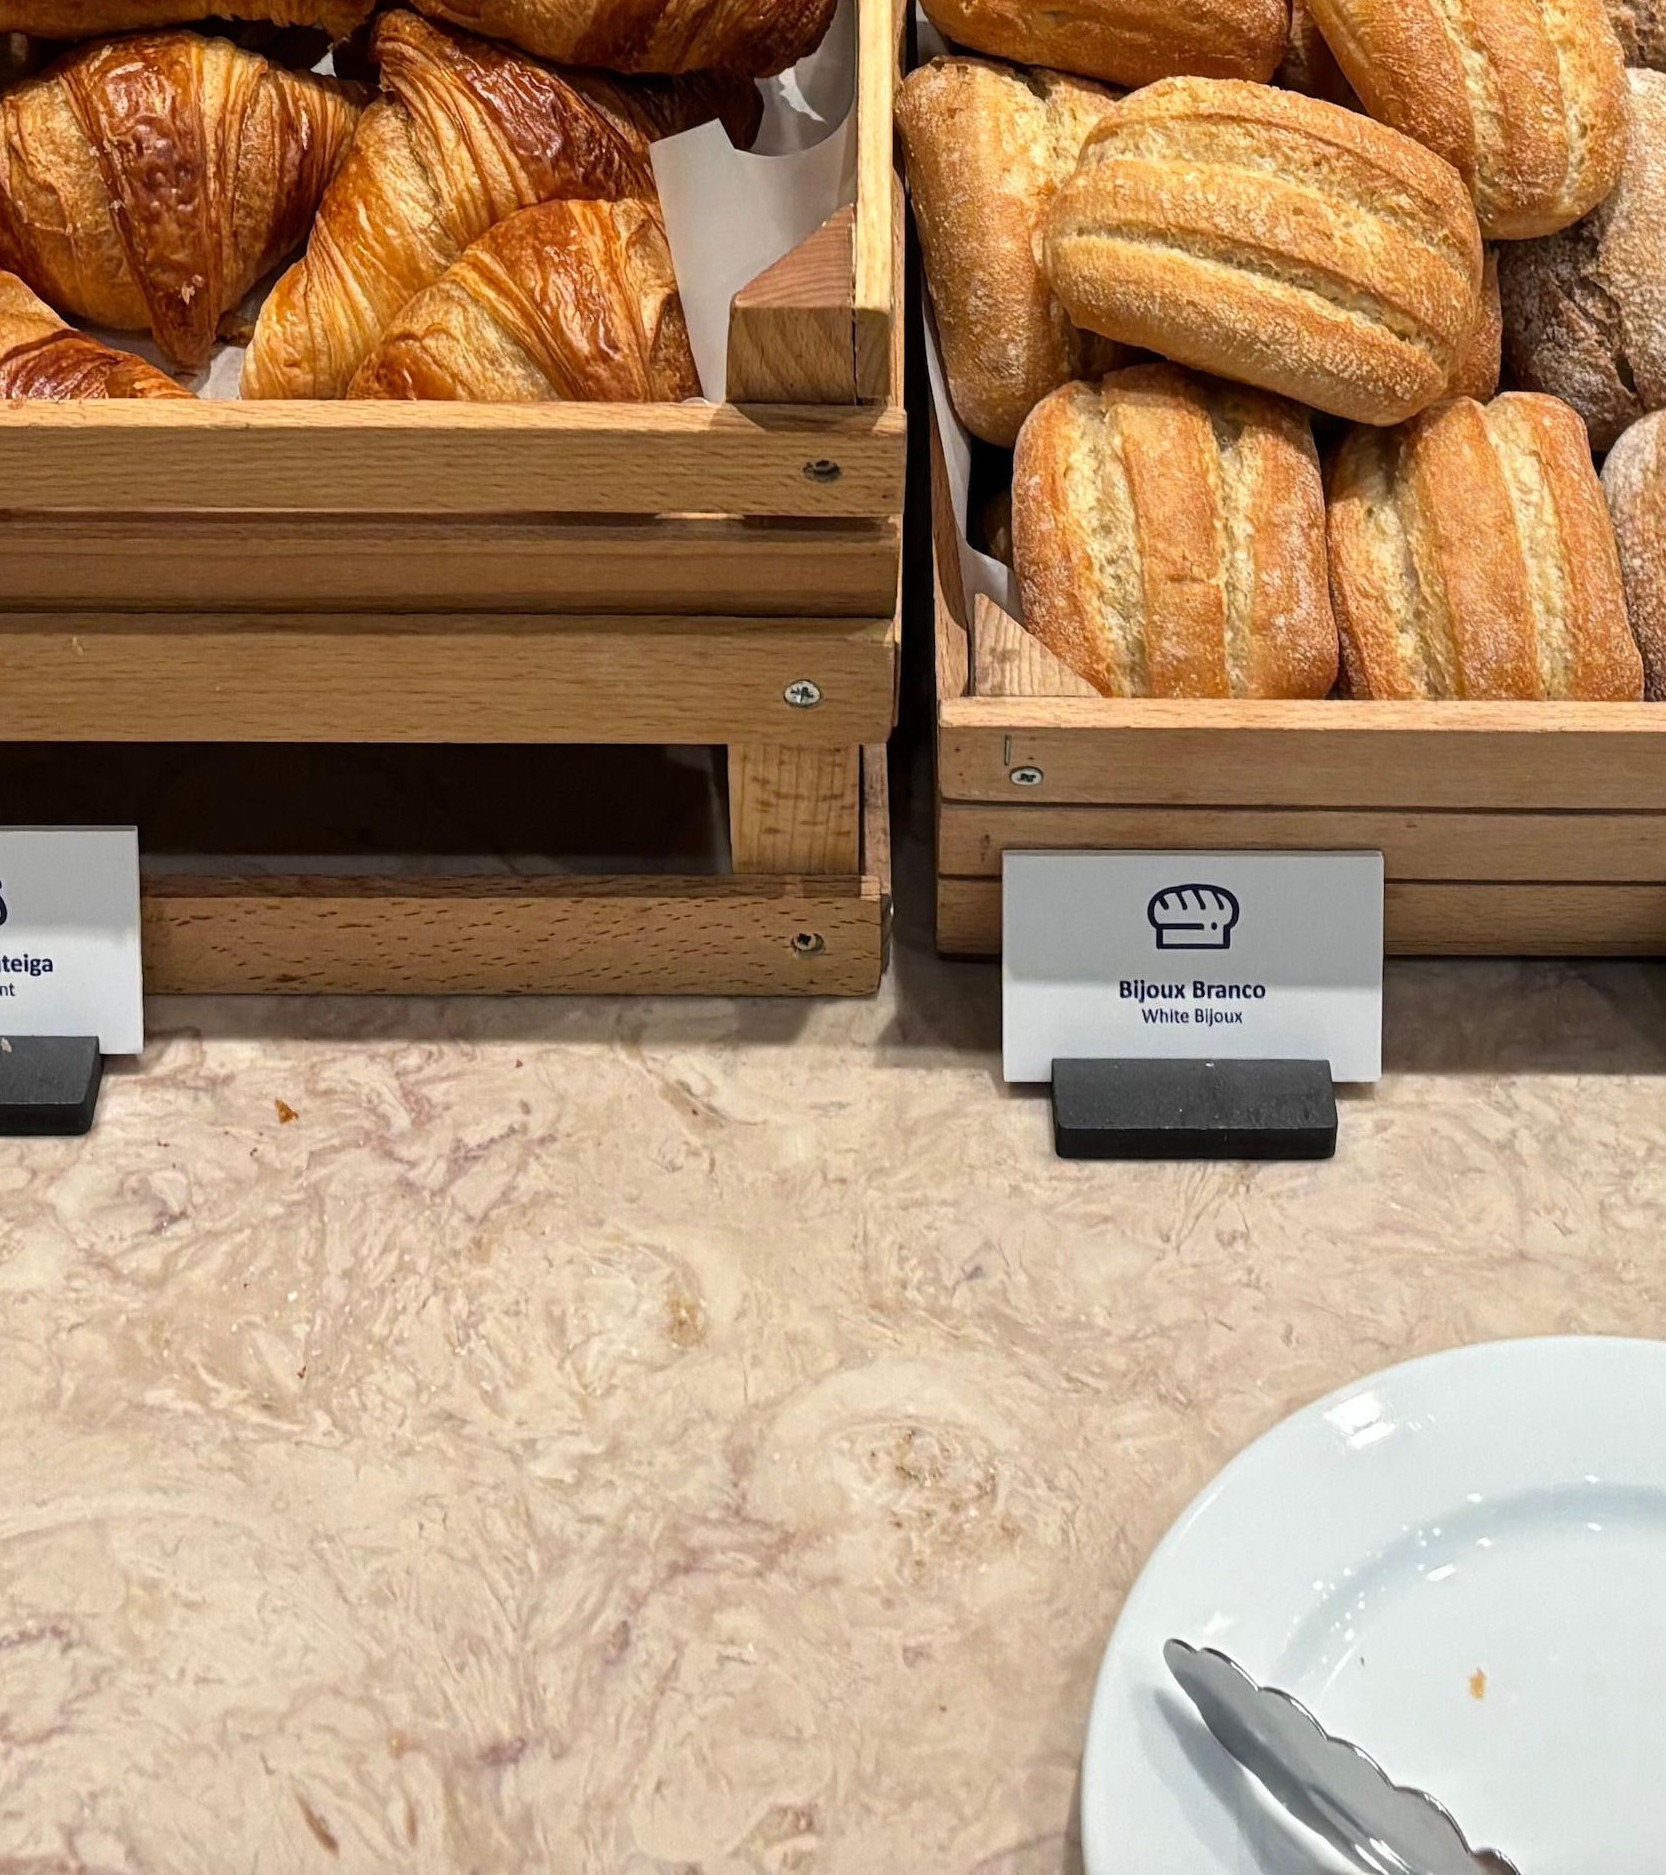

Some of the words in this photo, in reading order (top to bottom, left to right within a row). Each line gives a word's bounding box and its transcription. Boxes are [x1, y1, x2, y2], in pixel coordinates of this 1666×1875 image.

[1118, 977, 1187, 1004] Bijoux
[1191, 979, 1267, 1000] Branco
[1141, 1007, 1190, 1025] White
[1194, 1007, 1243, 1028] Bijoux
